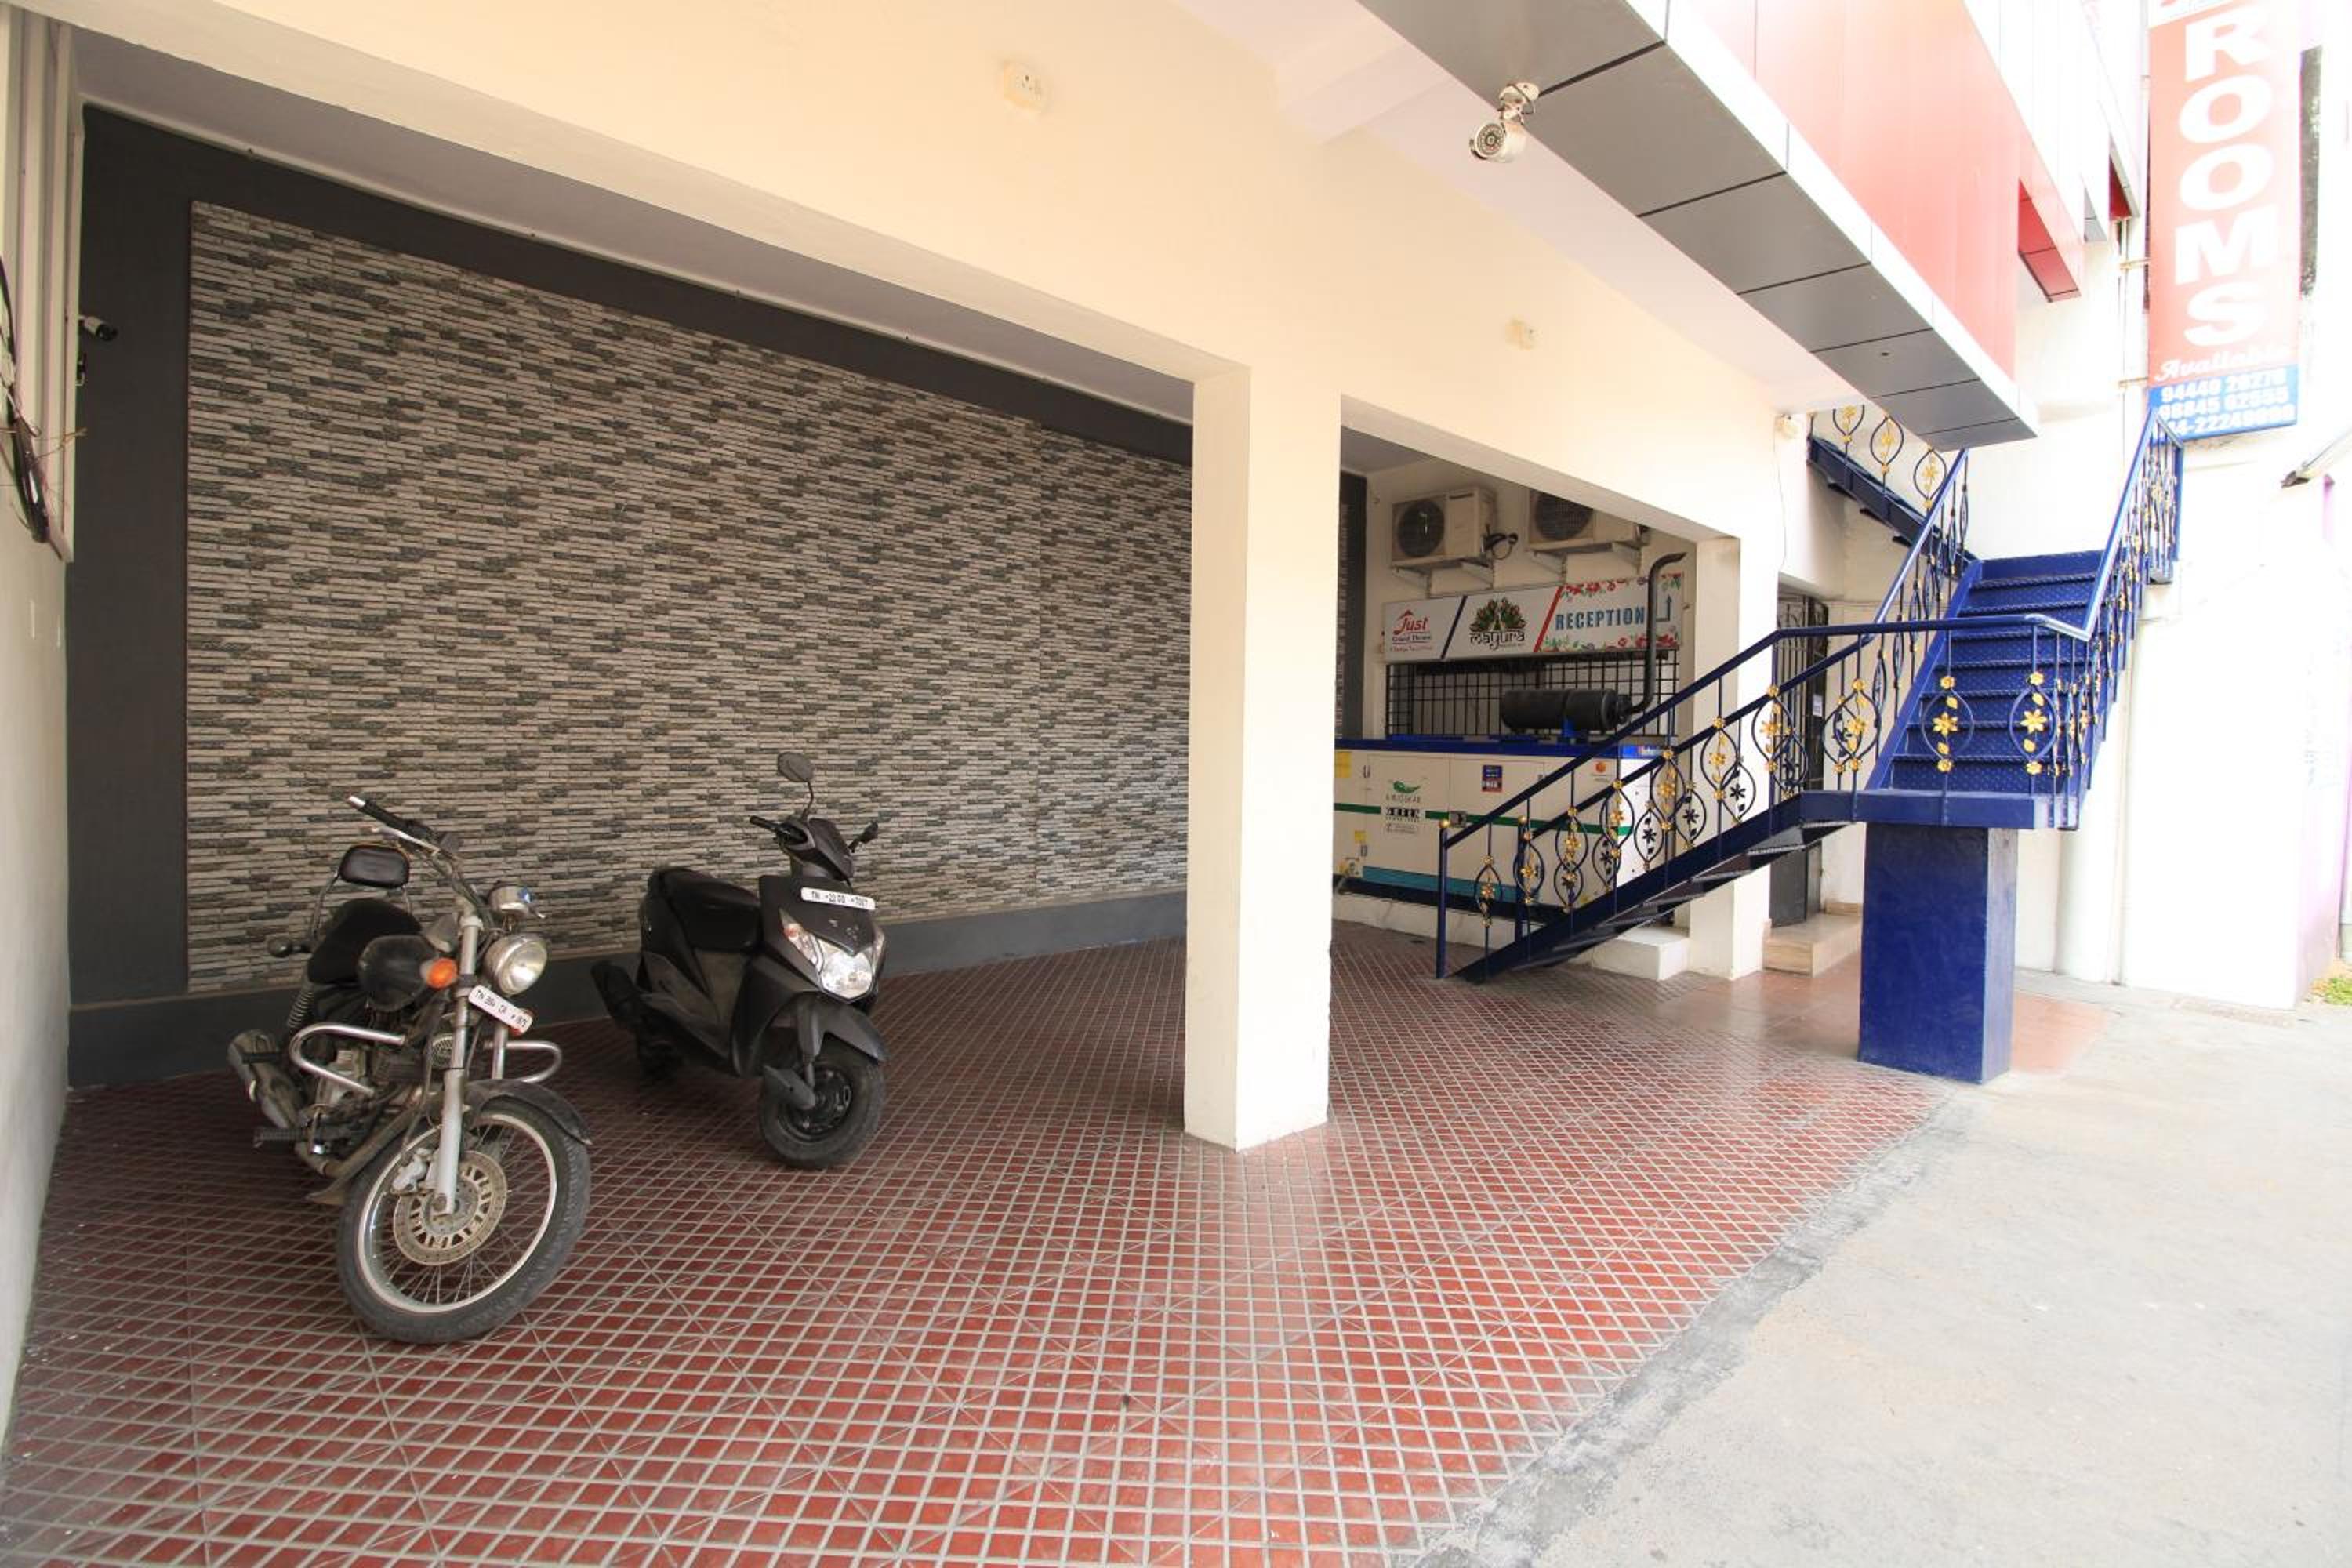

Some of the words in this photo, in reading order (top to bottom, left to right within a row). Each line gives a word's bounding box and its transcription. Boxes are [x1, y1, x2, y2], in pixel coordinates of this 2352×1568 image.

[2174, 6, 2278, 347] ROOMS
[1392, 616, 1430, 635] Just
[1555, 606, 1646, 630] RECEPTION
